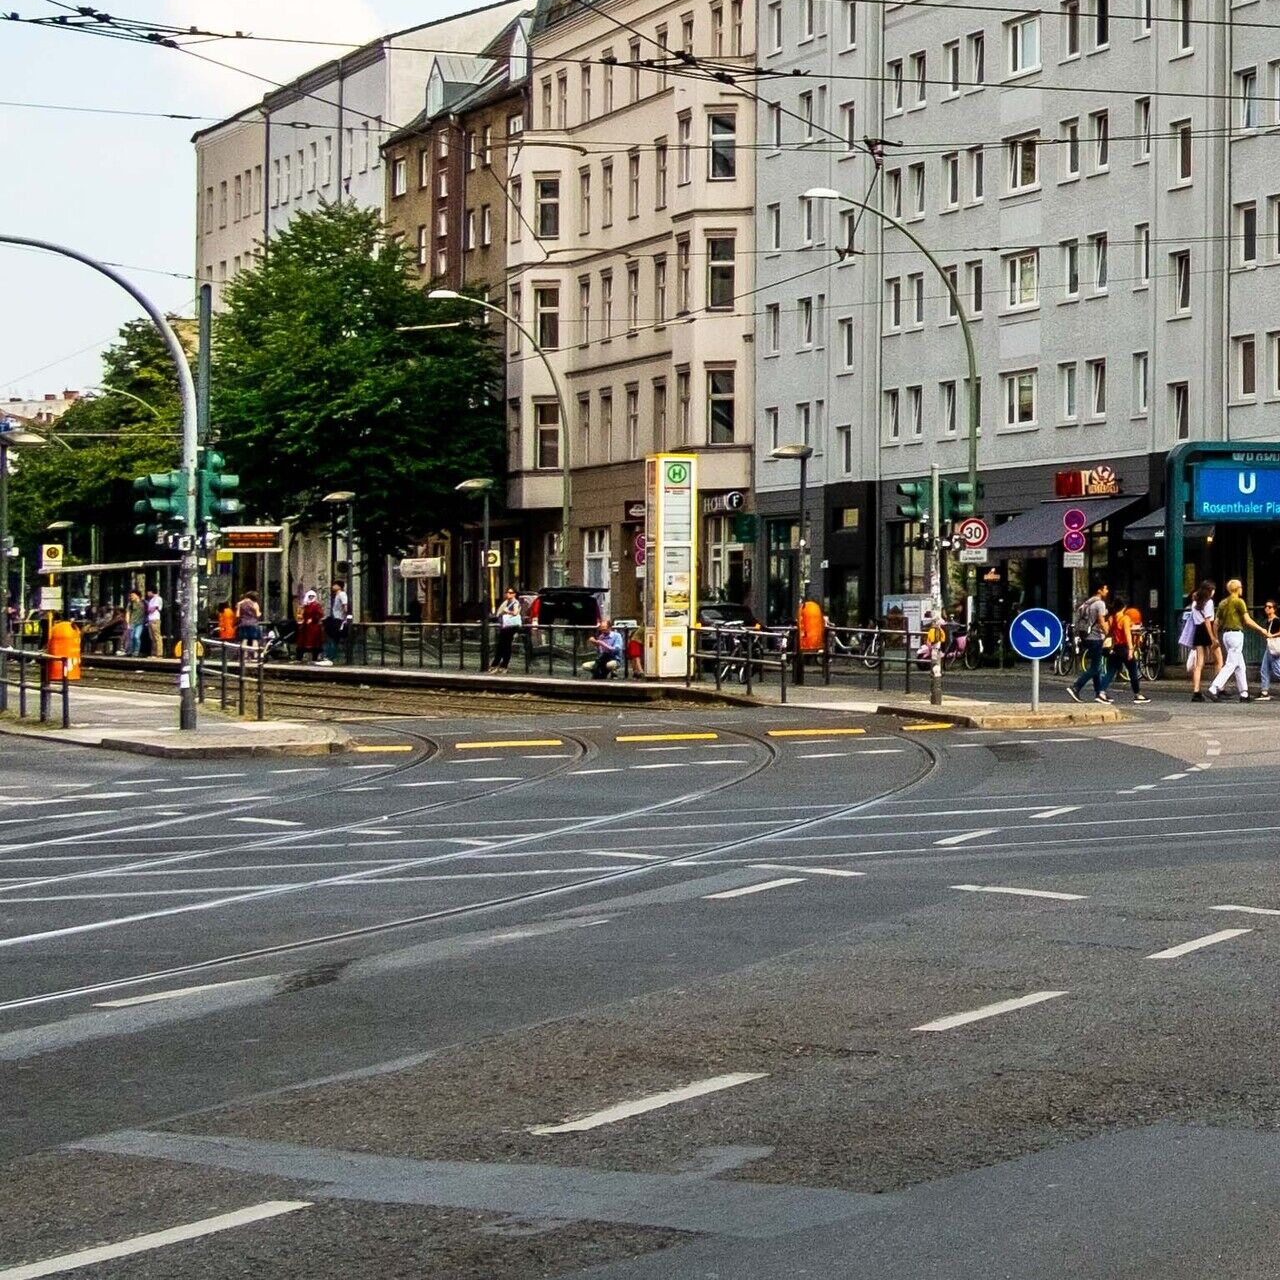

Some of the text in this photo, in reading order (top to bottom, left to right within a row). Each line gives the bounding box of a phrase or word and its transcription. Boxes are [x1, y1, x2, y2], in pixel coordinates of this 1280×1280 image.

[1238, 472, 1257, 495] U
[1203, 501, 1263, 513] Rosenthaler
[965, 527, 982, 539] 30
